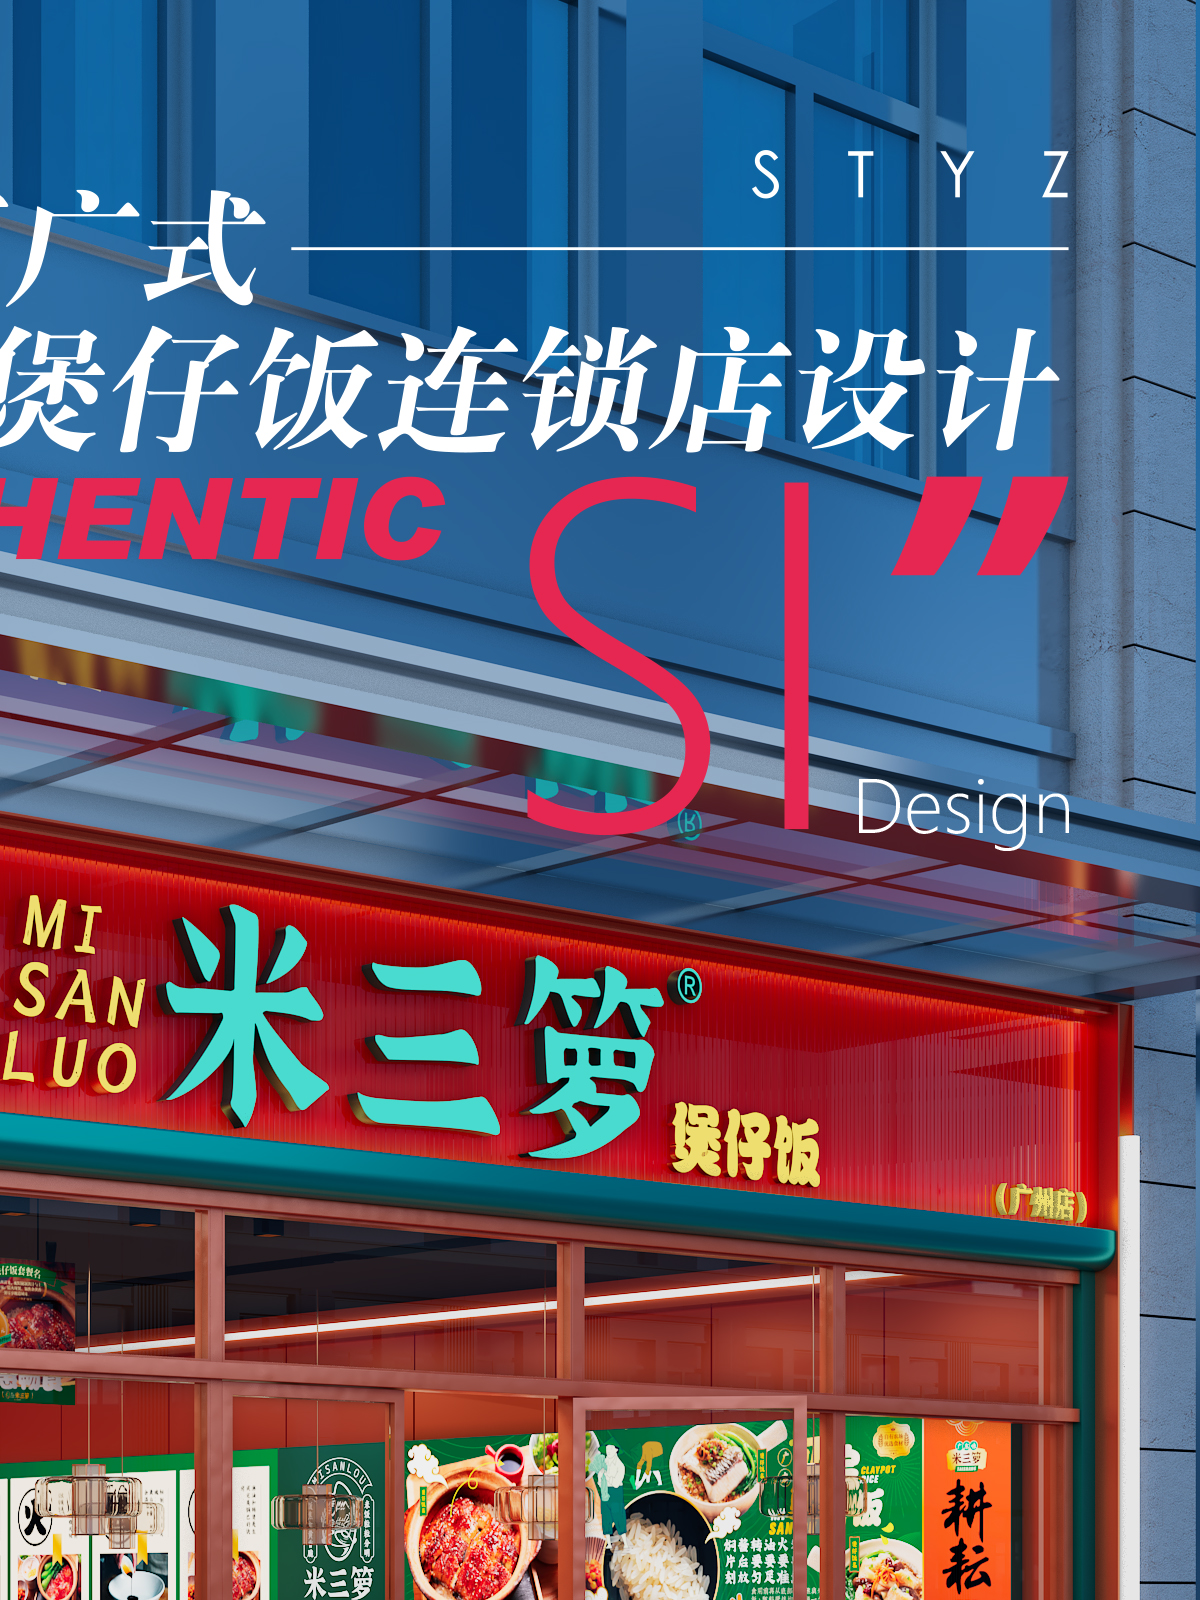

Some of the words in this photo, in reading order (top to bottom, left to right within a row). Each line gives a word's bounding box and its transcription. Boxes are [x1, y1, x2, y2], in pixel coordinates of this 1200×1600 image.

[21, 894, 103, 955] MI
[12, 961, 147, 1029] SAN
[1, 1030, 138, 1094] LUO
[158, 903, 665, 1160] 米三箩
[670, 1101, 821, 1188] 煲仔饭
[860, 1464, 897, 1475] CLAYPOT
[951, 1451, 982, 1465] 米三箩
[940, 1478, 993, 1595] 耕耘
[303, 1565, 375, 1600] 米三箩
